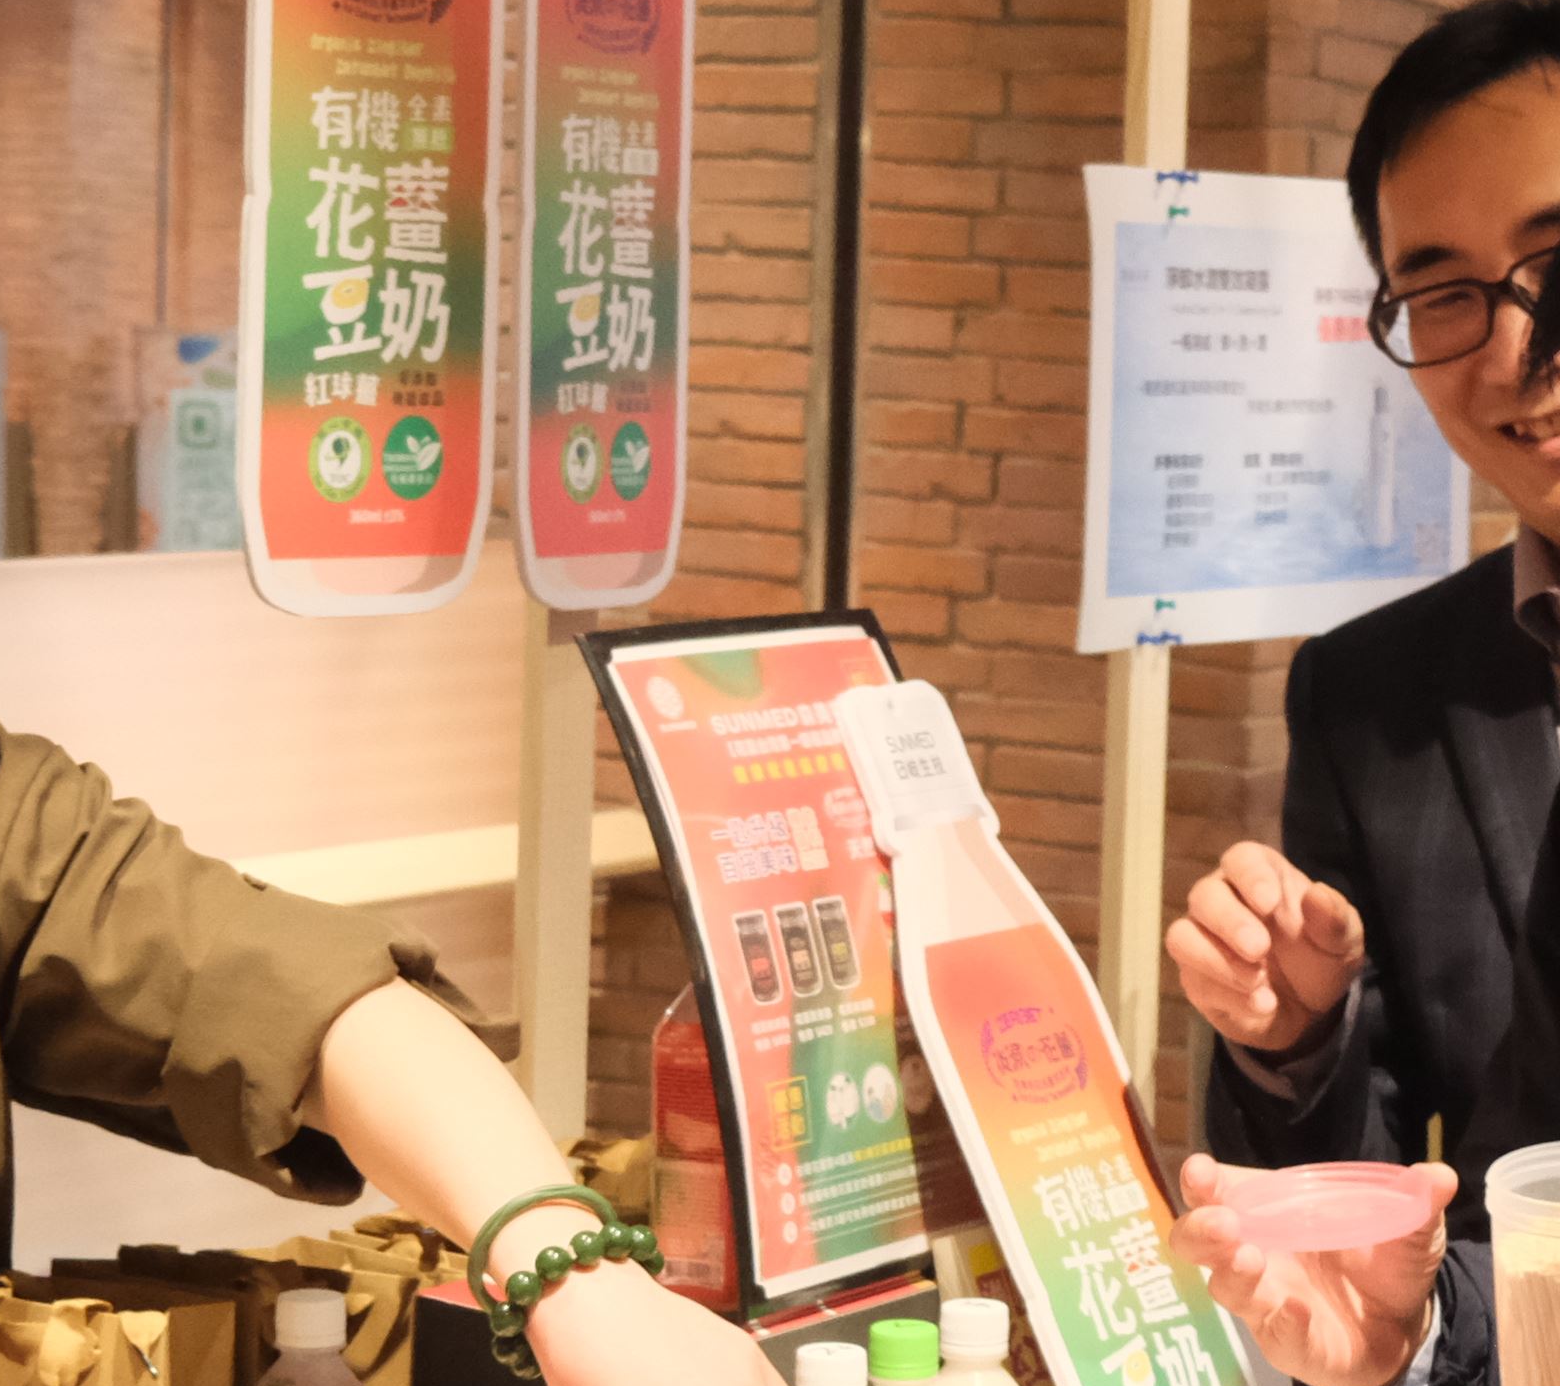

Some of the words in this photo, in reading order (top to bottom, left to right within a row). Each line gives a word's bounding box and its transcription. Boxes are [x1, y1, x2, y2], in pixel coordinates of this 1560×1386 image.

[310, 85, 401, 153] 有機
[561, 113, 620, 173] 有機
[306, 156, 451, 264] 花薑
[558, 180, 655, 281] 花薑
[301, 264, 450, 364] 豆奶
[556, 280, 655, 372] 豆奶
[885, 731, 936, 756] SUNMED
[1033, 1166, 1109, 1237] 有機
[1063, 1216, 1190, 1342] 花薑
